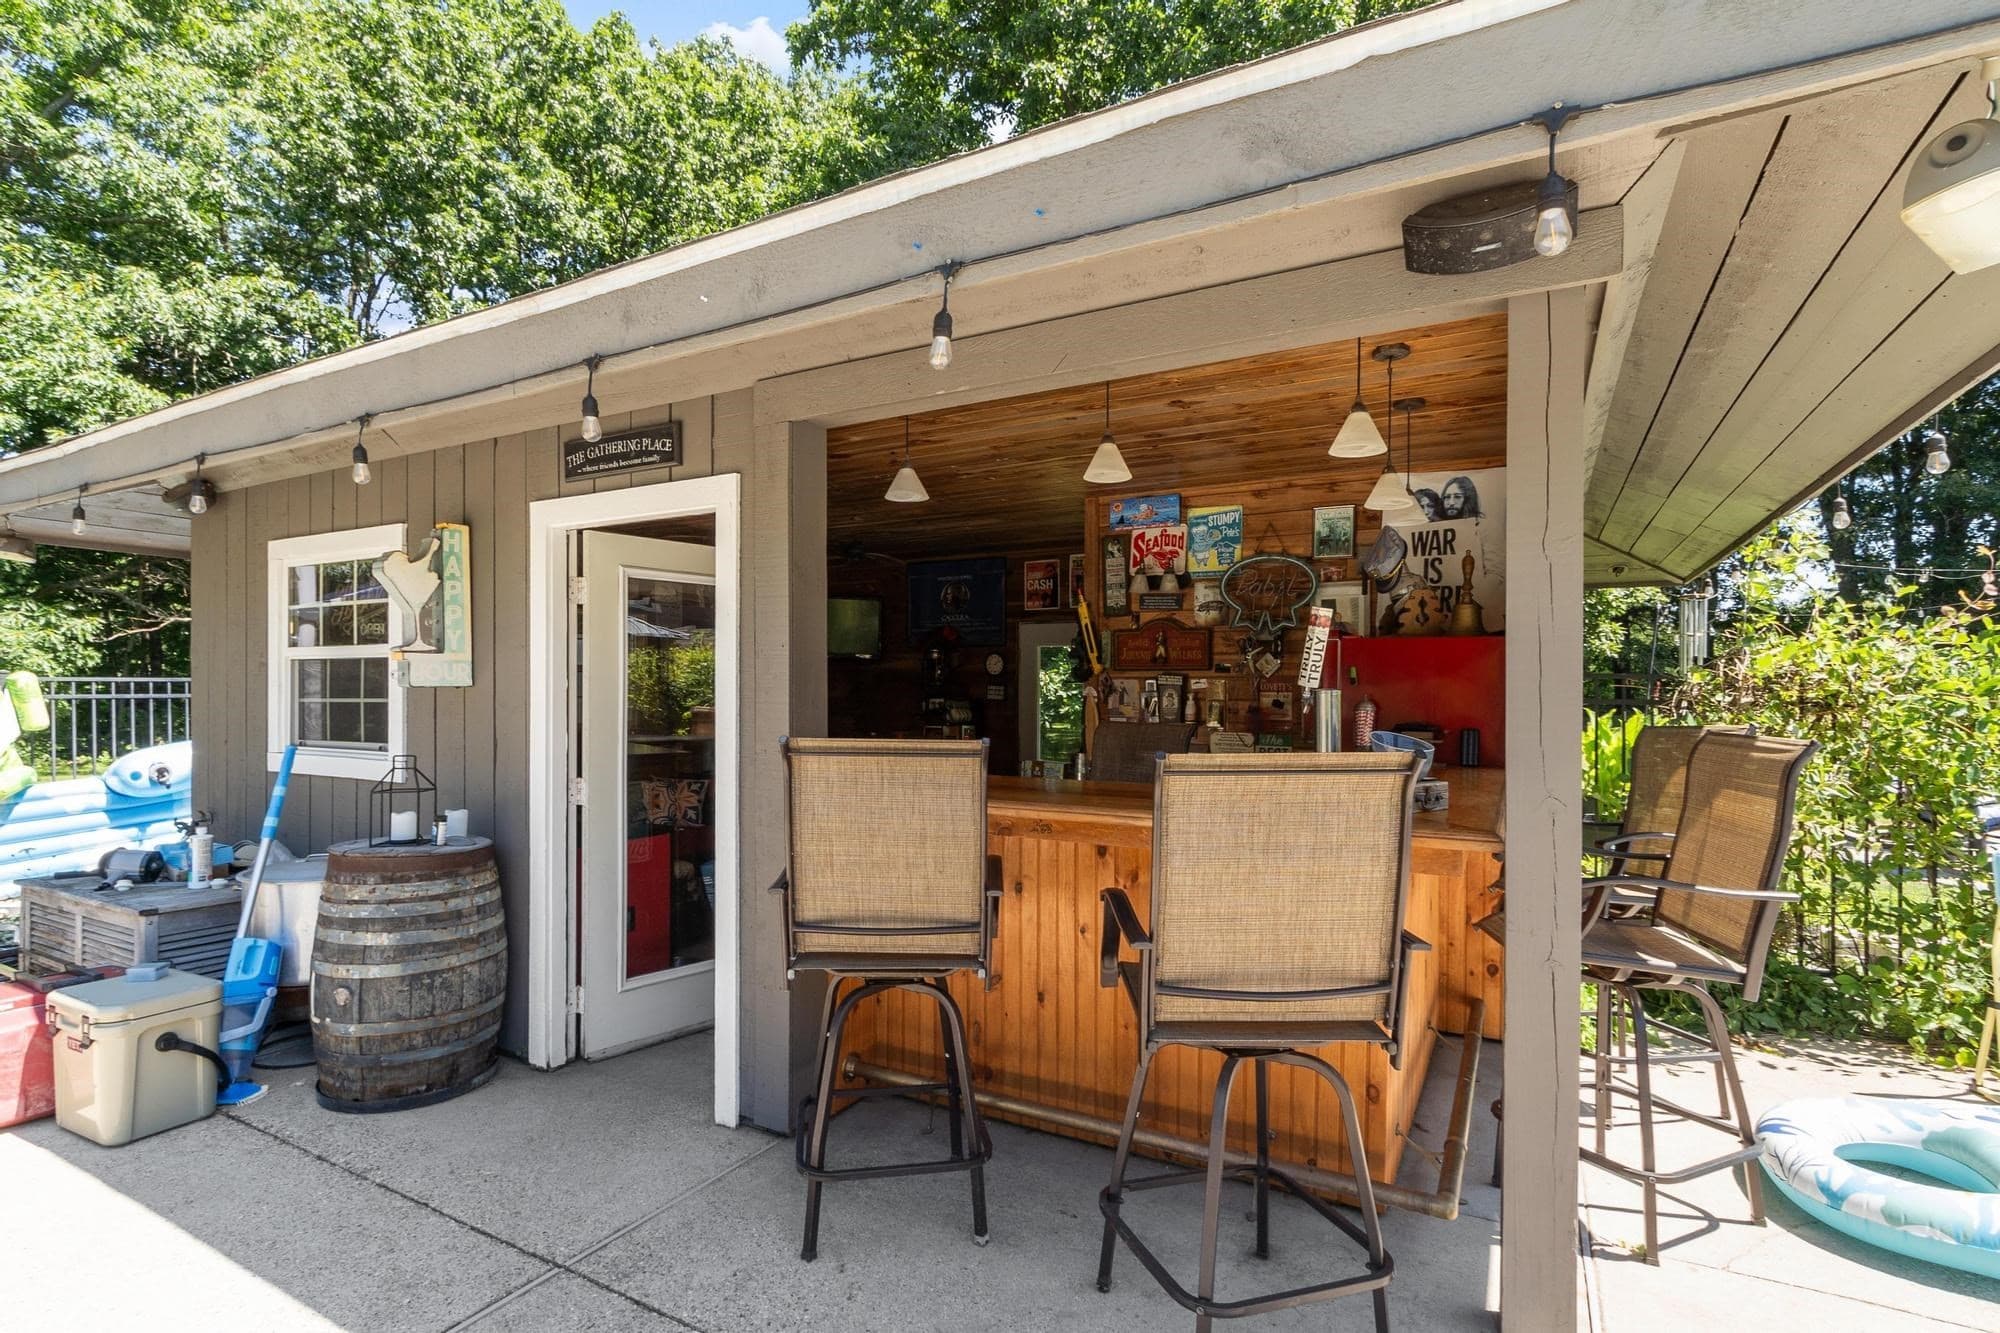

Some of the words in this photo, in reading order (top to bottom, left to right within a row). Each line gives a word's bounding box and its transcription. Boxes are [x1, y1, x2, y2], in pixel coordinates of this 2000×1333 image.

[566, 451, 585, 467] THE
[586, 439, 641, 459] GATHERING
[642, 438, 672, 451] PLACE
[599, 459, 619, 471] friends
[619, 457, 641, 467] become
[642, 454, 661, 464] family
[1208, 511, 1240, 527] STUMPY
[1220, 525, 1240, 537] Pete's
[1411, 528, 1457, 557] WAR
[1423, 557, 1443, 584] IS
[443, 531, 462, 650] HAPPY
[1027, 578, 1053, 592] CASH
[360, 623, 385, 636] OPEN
[1300, 635, 1314, 680] TRULY
[1307, 636, 1326, 683] TRULY
